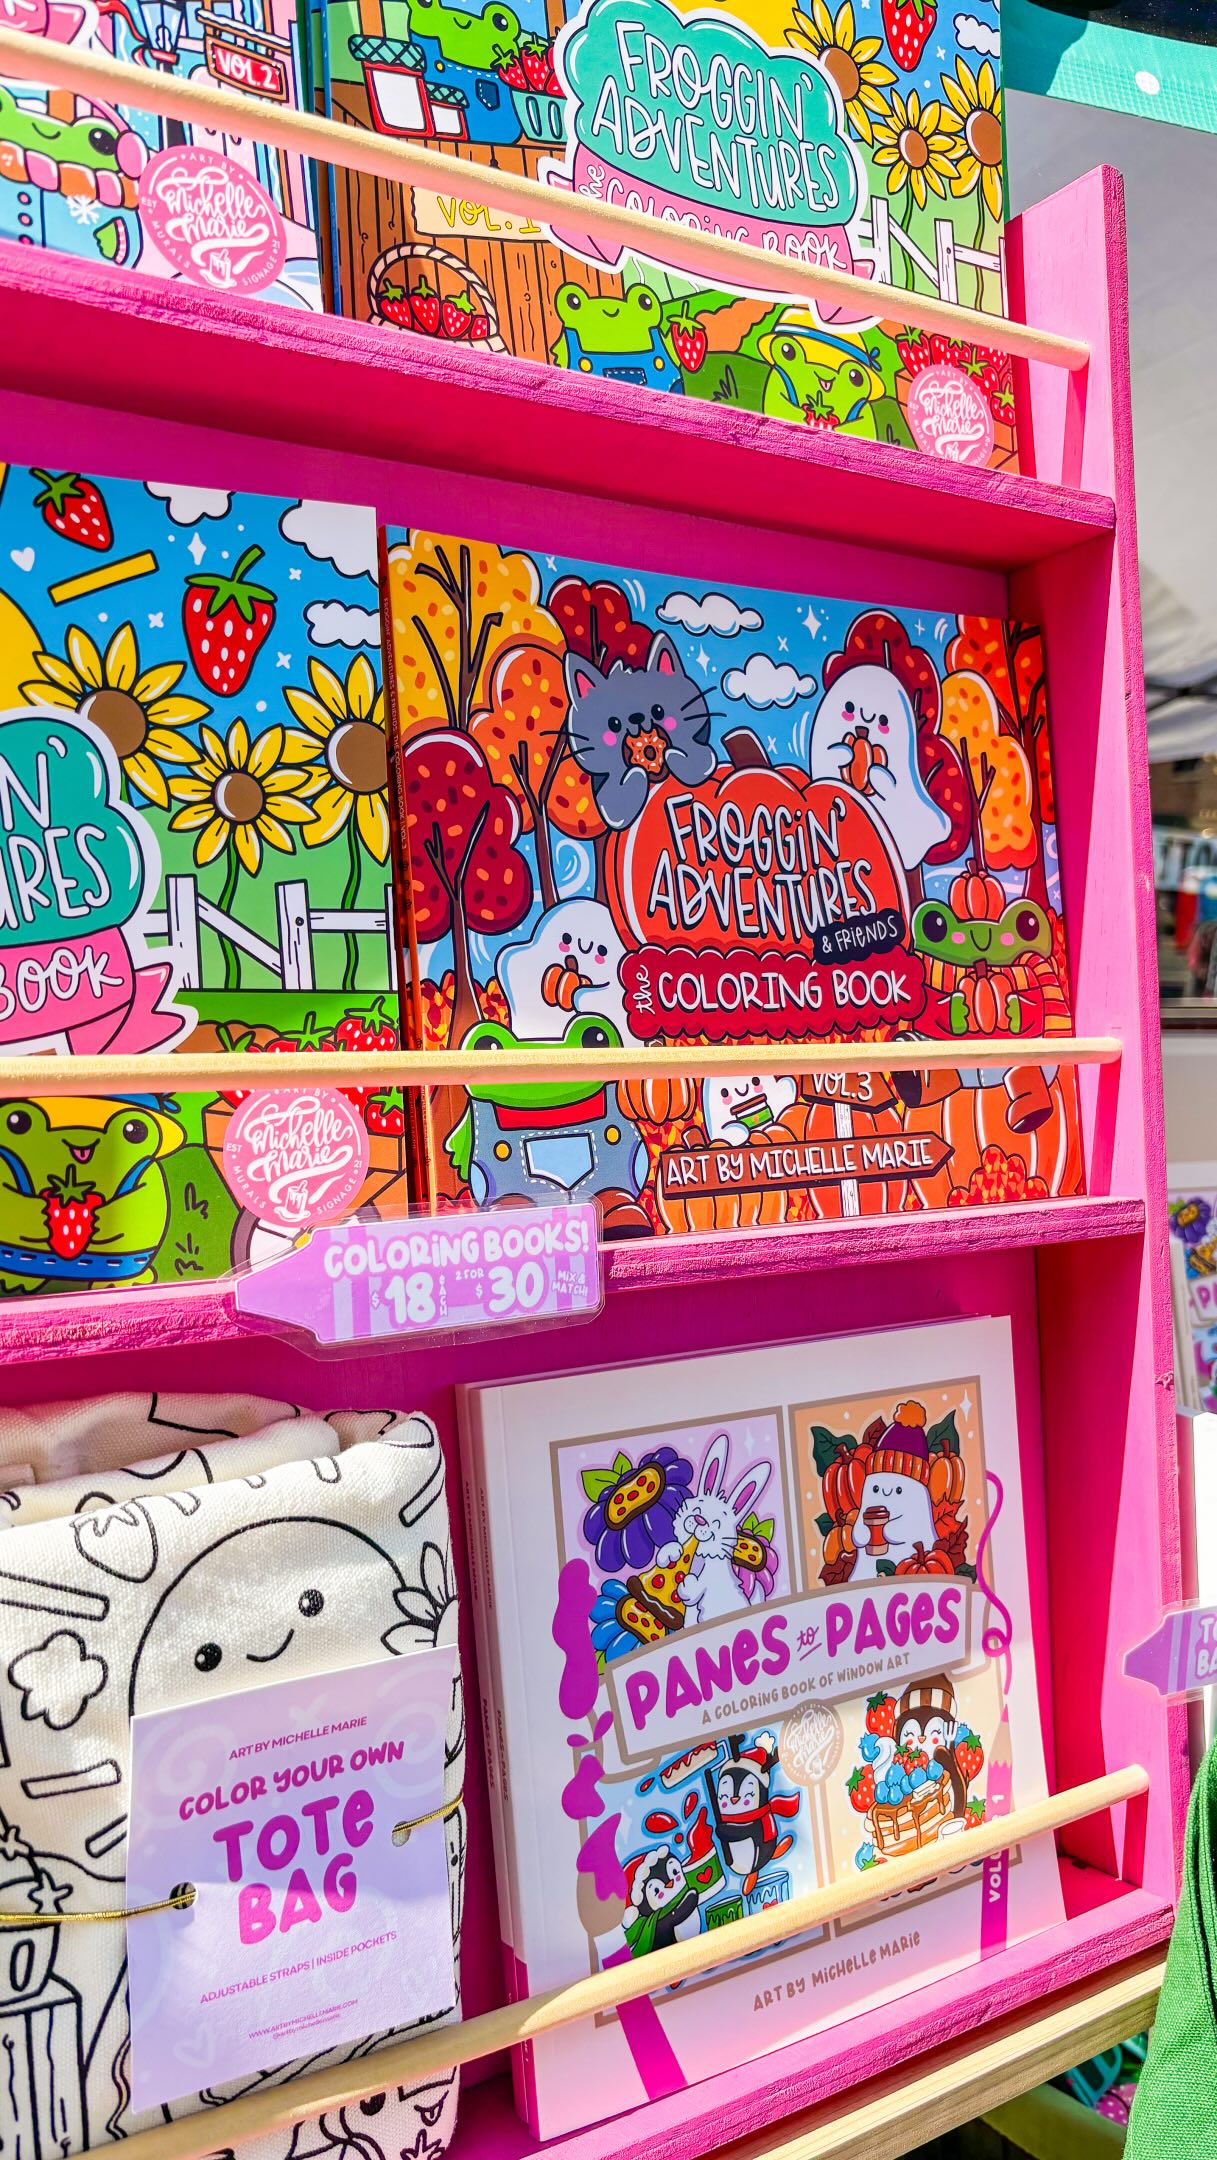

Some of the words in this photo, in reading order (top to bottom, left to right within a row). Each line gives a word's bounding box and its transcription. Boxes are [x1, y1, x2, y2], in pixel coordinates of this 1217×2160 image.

[615, 20, 813, 141] FROGGIN'
[189, 153, 214, 165] ART
[221, 162, 236, 174] BY
[592, 75, 839, 212] ADVENTURES
[156, 166, 266, 220] Michelle
[579, 164, 606, 198] he
[141, 197, 157, 209] EST
[151, 219, 191, 270] MURALS
[165, 213, 270, 252] Marie
[242, 256, 278, 287] SIGNAGE
[648, 848, 878, 943] ADVENTURES
[822, 935, 833, 954] &
[632, 964, 656, 1015] the
[657, 971, 823, 1012] COLORING
[832, 968, 912, 1009] BOOK
[314, 1088, 329, 1100] BY
[243, 1095, 354, 1155] Michelle
[226, 1143, 243, 1153] EST
[246, 1145, 354, 1182] Marie
[666, 1153, 710, 1186] ART
[717, 1152, 743, 1183] BY
[749, 1144, 857, 1179] MICHELLE
[862, 1138, 934, 1171] MARIE
[232, 1165, 267, 1209] MURALS
[316, 1178, 357, 1215] SIGNAGE
[483, 1219, 590, 1262] BOOKS!
[464, 1267, 485, 1280] FOR
[551, 1281, 589, 1298] MATCH!
[796, 1626, 820, 1654] to
[702, 1709, 713, 1725] A
[781, 1677, 816, 1701] BOOK
[818, 1672, 835, 1687] OF
[886, 1652, 911, 1670] ART
[228, 1744, 254, 1760] ART
[254, 1741, 270, 1754] BY
[271, 1725, 330, 1749] MICHELLE
[330, 1716, 368, 1734] MARIE
[179, 1775, 268, 1821] COLOR
[273, 1754, 345, 1793] YOUR
[349, 1741, 405, 1771] OWN
[238, 1852, 357, 1945] BAG
[200, 1974, 269, 2004] ADJUSTABLE
[269, 1960, 311, 1982] STRAPS
[316, 1947, 349, 1967] INSIDE
[350, 1930, 398, 1955] POCKETS
[752, 1985, 783, 2012] ART
[786, 1977, 806, 1999] BY
